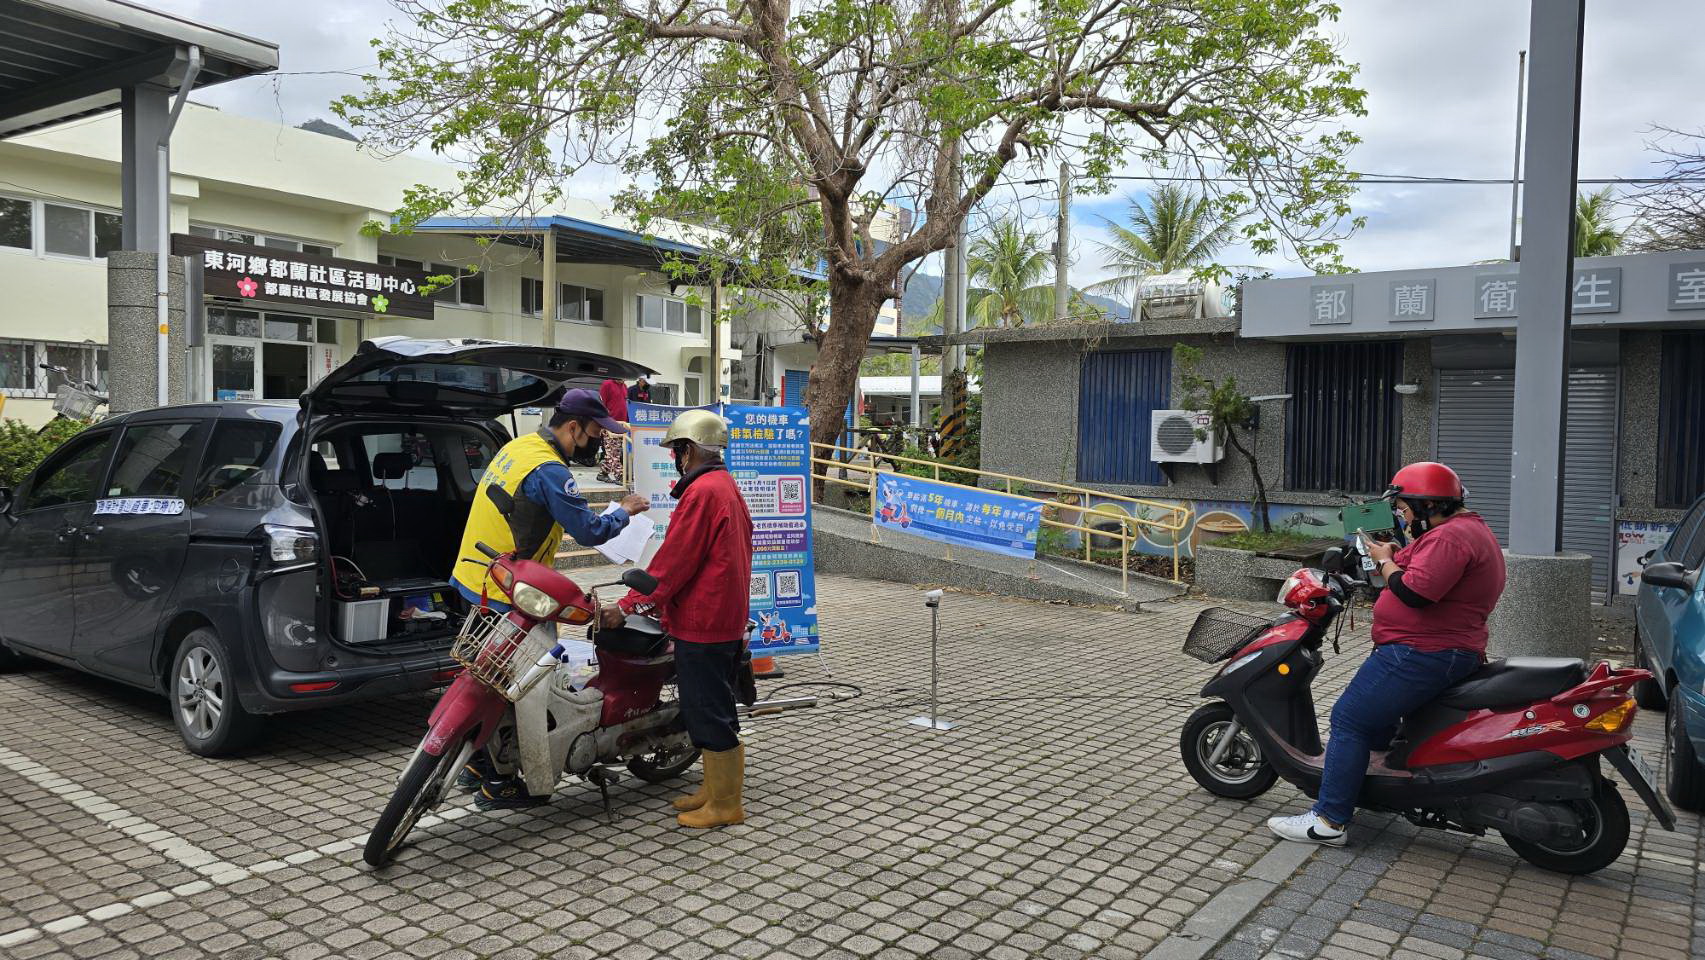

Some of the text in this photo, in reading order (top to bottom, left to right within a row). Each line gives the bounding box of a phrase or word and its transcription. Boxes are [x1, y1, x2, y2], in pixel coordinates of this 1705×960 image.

[203, 250, 417, 296] 東河鄉都蘭社區活動中心
[264, 282, 369, 306] 都蘭社區發展協會
[634, 409, 682, 423] 機車檢
[745, 413, 789, 426] 您的機車
